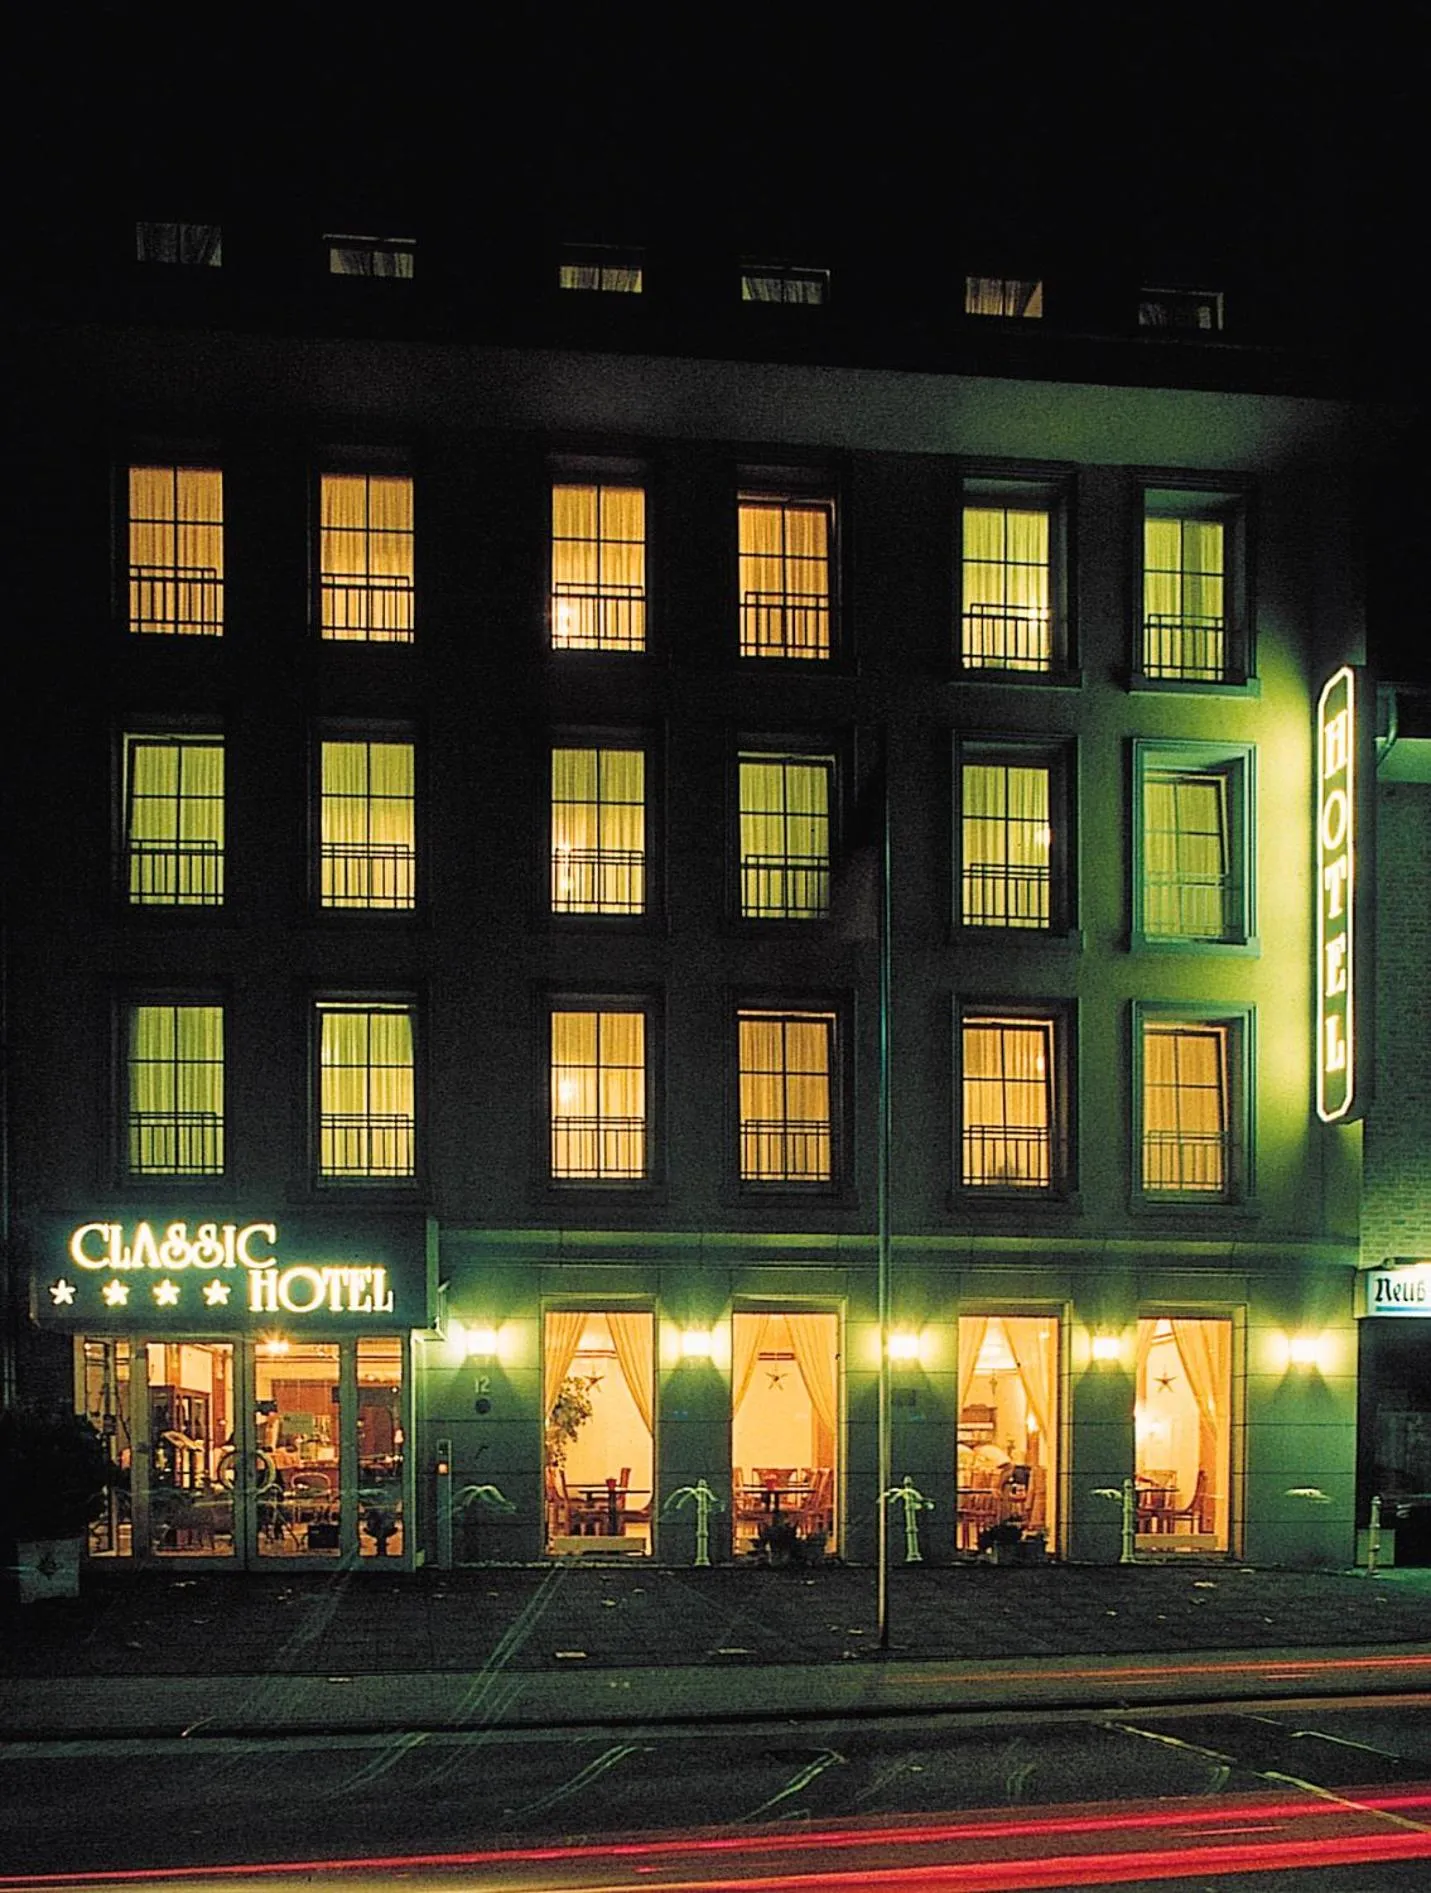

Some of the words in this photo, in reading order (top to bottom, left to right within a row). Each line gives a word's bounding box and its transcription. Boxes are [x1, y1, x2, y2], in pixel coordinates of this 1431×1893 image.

[1323, 709, 1347, 1073] HOTEL
[70, 1222, 277, 1269] CLASSIC
[248, 1267, 394, 1312] HOTEL
[474, 1376, 490, 1393] 12
